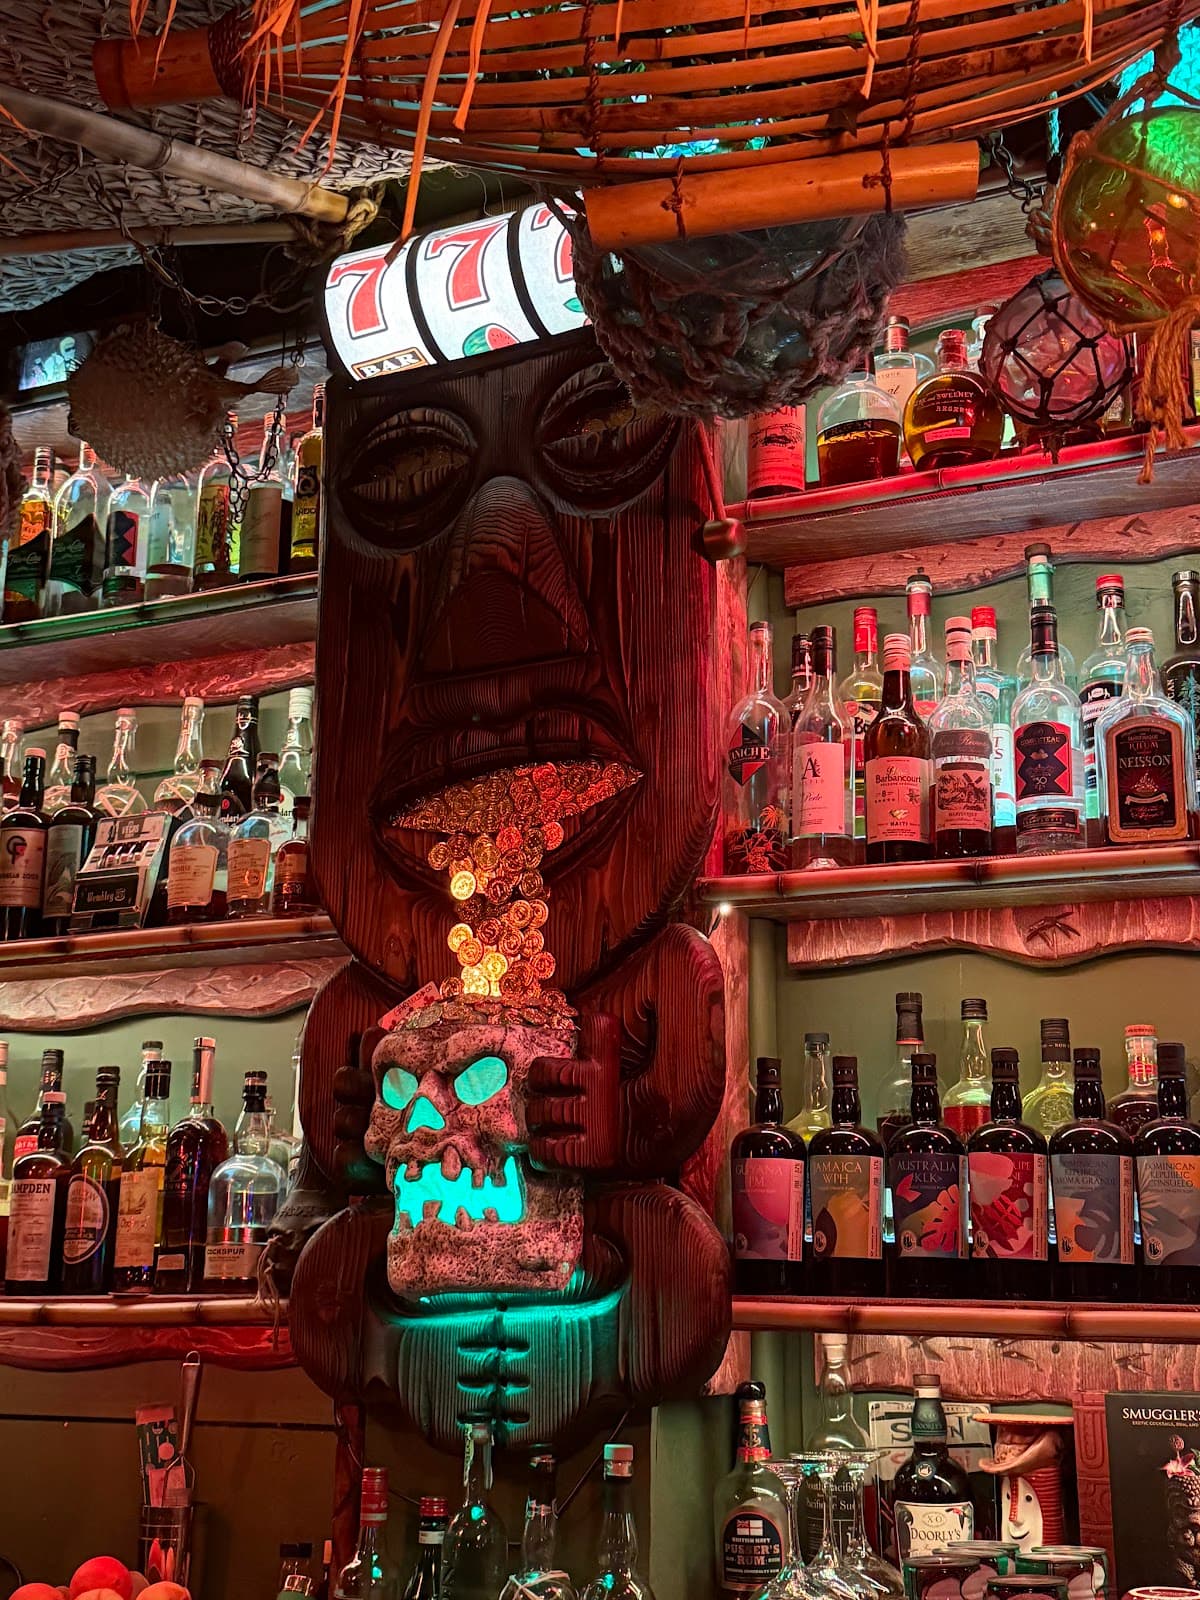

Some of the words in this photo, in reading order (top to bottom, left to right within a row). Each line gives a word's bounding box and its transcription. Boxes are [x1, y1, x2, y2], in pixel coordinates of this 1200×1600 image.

[325, 254, 390, 339] 7
[424, 219, 509, 311] 7
[359, 353, 420, 378] BAR
[936, 391, 974, 399] SWEENEY
[1129, 741, 1159, 750] RHUM
[1119, 754, 1172, 769] NEISSON
[875, 774, 922, 784] Barbancourt
[897, 1160, 958, 1172] AUSTRALIA
[11, 1183, 51, 1194] AMPDEN
[910, 1526, 961, 1543] DOORLY'S
[724, 1543, 780, 1555] PUSSER'S
[736, 1555, 766, 1566] RUM
